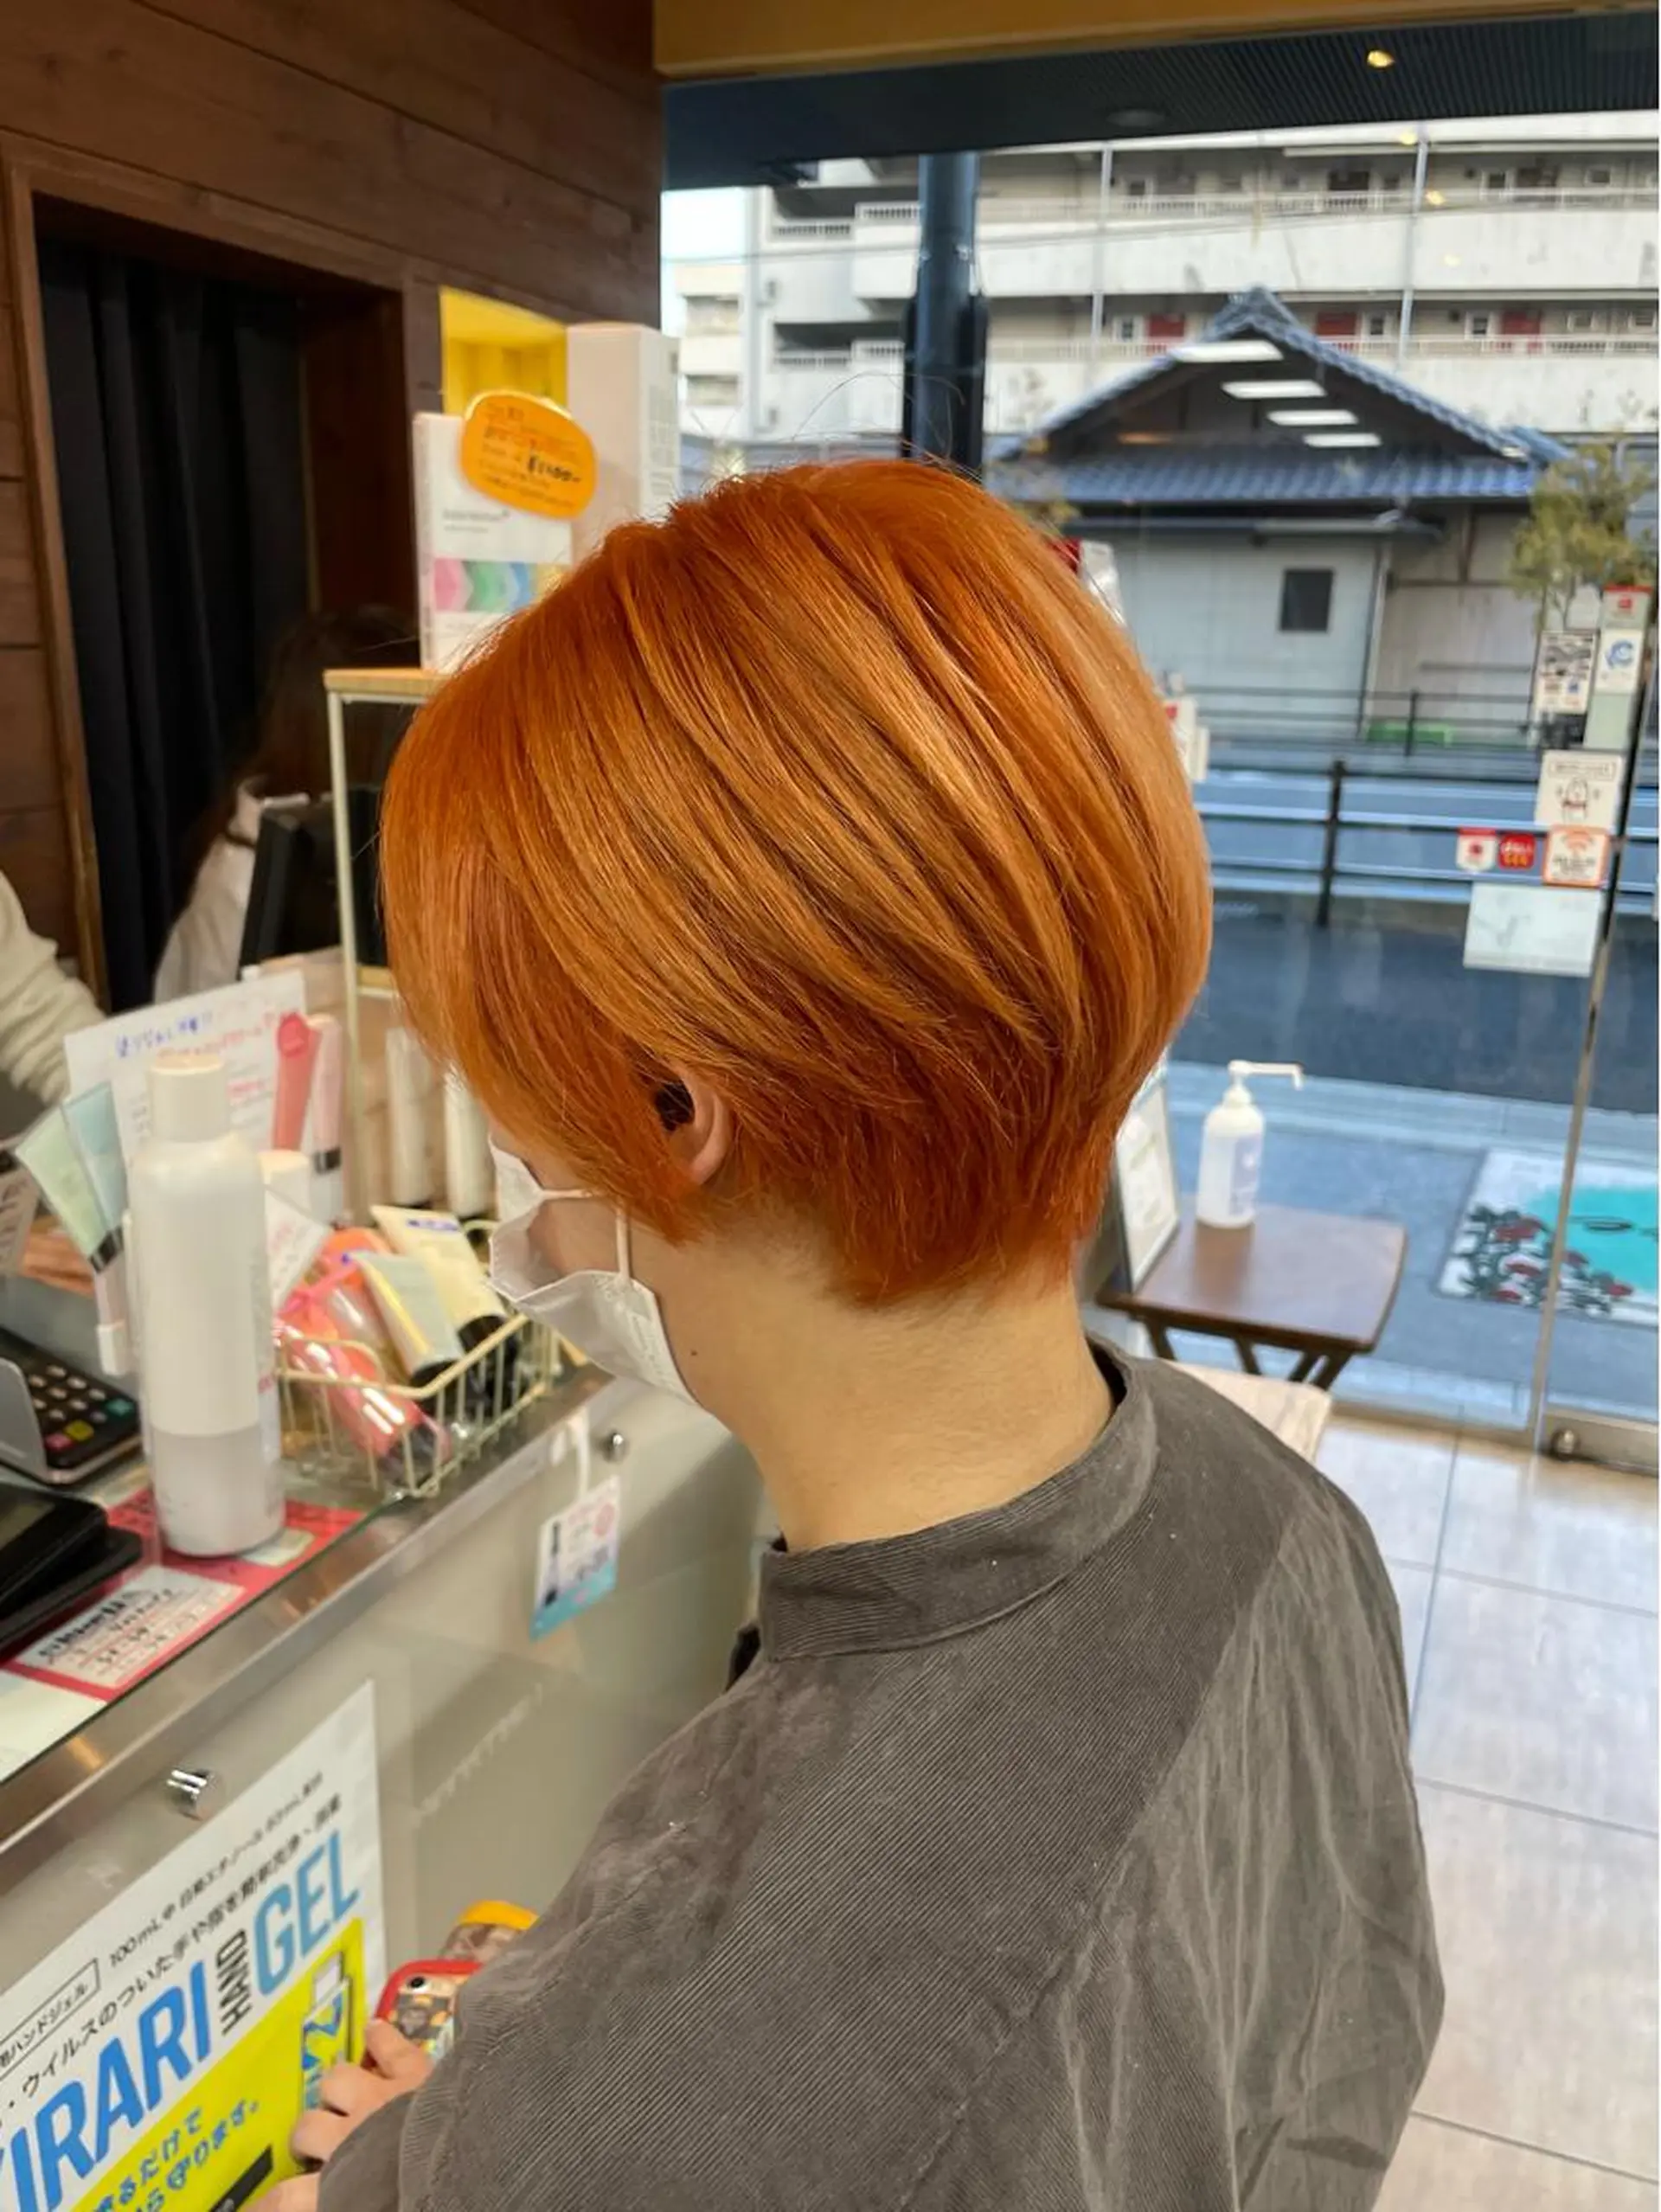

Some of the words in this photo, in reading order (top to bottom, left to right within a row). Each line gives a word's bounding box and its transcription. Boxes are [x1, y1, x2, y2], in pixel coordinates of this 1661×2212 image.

[0, 1960, 211, 2212] IRARI
[215, 1928, 252, 2036] HAND
[253, 1827, 360, 1996] GEL
